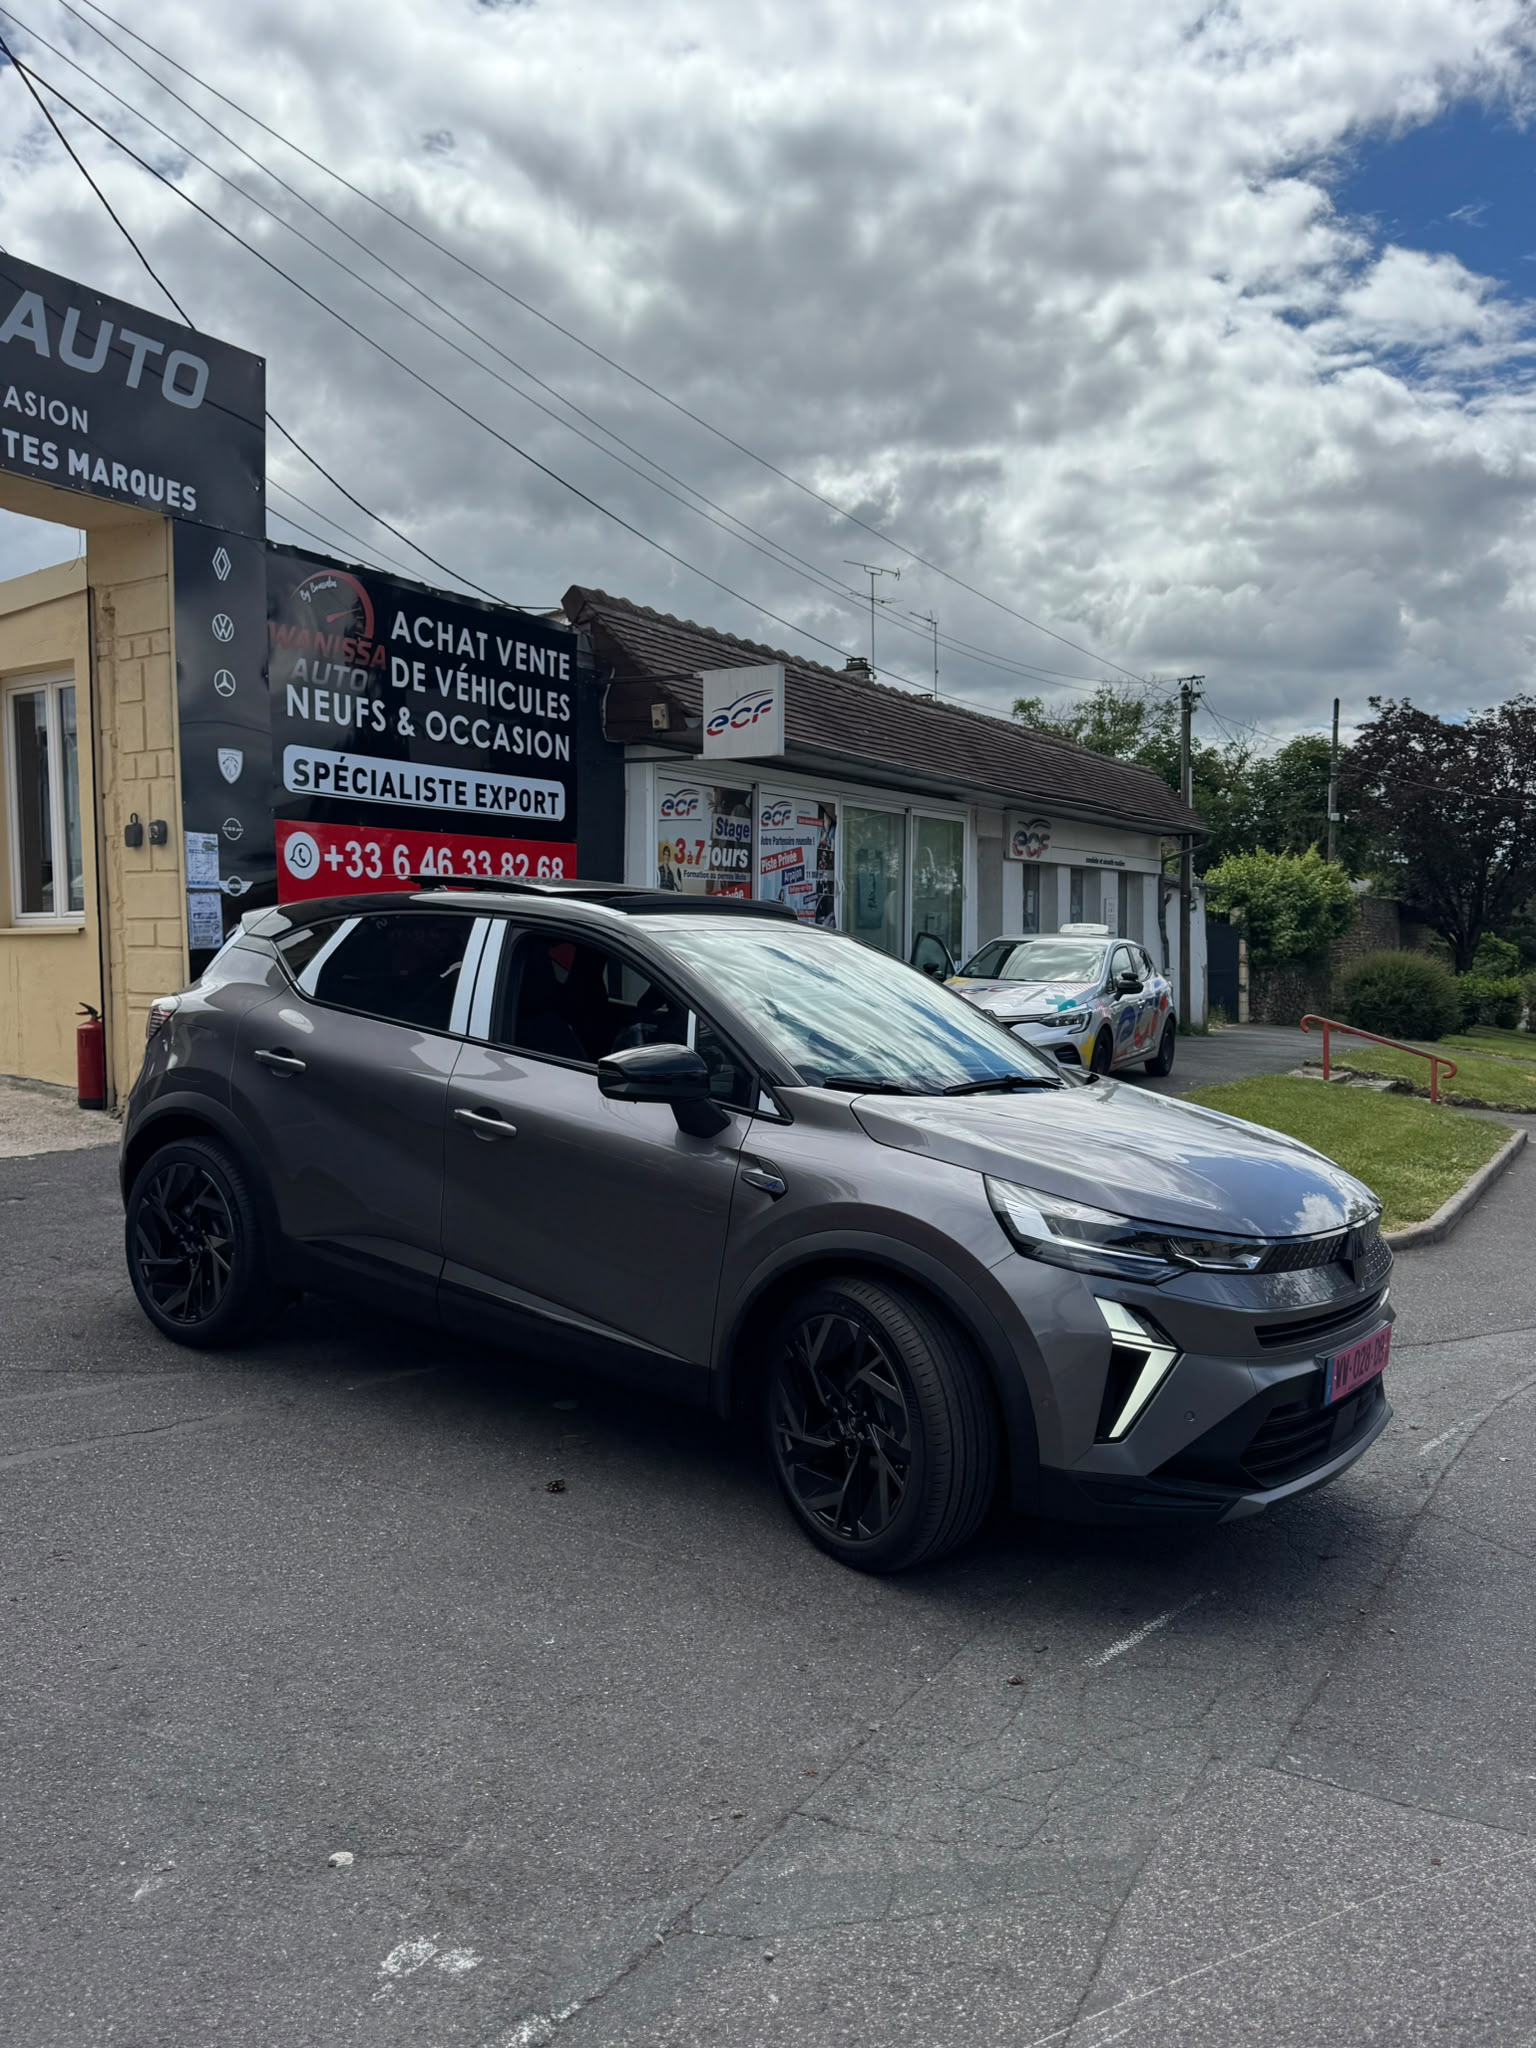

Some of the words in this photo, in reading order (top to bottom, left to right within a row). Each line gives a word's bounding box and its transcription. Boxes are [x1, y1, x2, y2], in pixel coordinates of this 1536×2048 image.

[0, 290, 209, 409] AUTO
[4, 386, 88, 433] ASION
[2, 428, 58, 470] TES
[68, 448, 196, 511] MARQUES
[269, 622, 386, 671] WANISSA
[391, 611, 488, 661] ACHAT
[497, 636, 570, 681] VENTE
[291, 657, 368, 692] AUTO
[391, 656, 426, 693] DE
[435, 663, 570, 722] VÉHICULES
[286, 684, 386, 732] NEUFS
[397, 706, 415, 737] &
[426, 711, 570, 762] OCCASION
[293, 755, 468, 806] SPÉCIALISTE
[475, 784, 560, 815] EXPORT
[674, 837, 686, 865] 3
[695, 840, 705, 865] 7
[704, 840, 748, 870] jours
[715, 816, 750, 841] Stage
[324, 841, 382, 879] +33
[393, 845, 411, 880] 6
[420, 846, 454, 876] 46
[462, 849, 493, 876] 33
[501, 852, 529, 877] 82
[537, 855, 564, 880] 68
